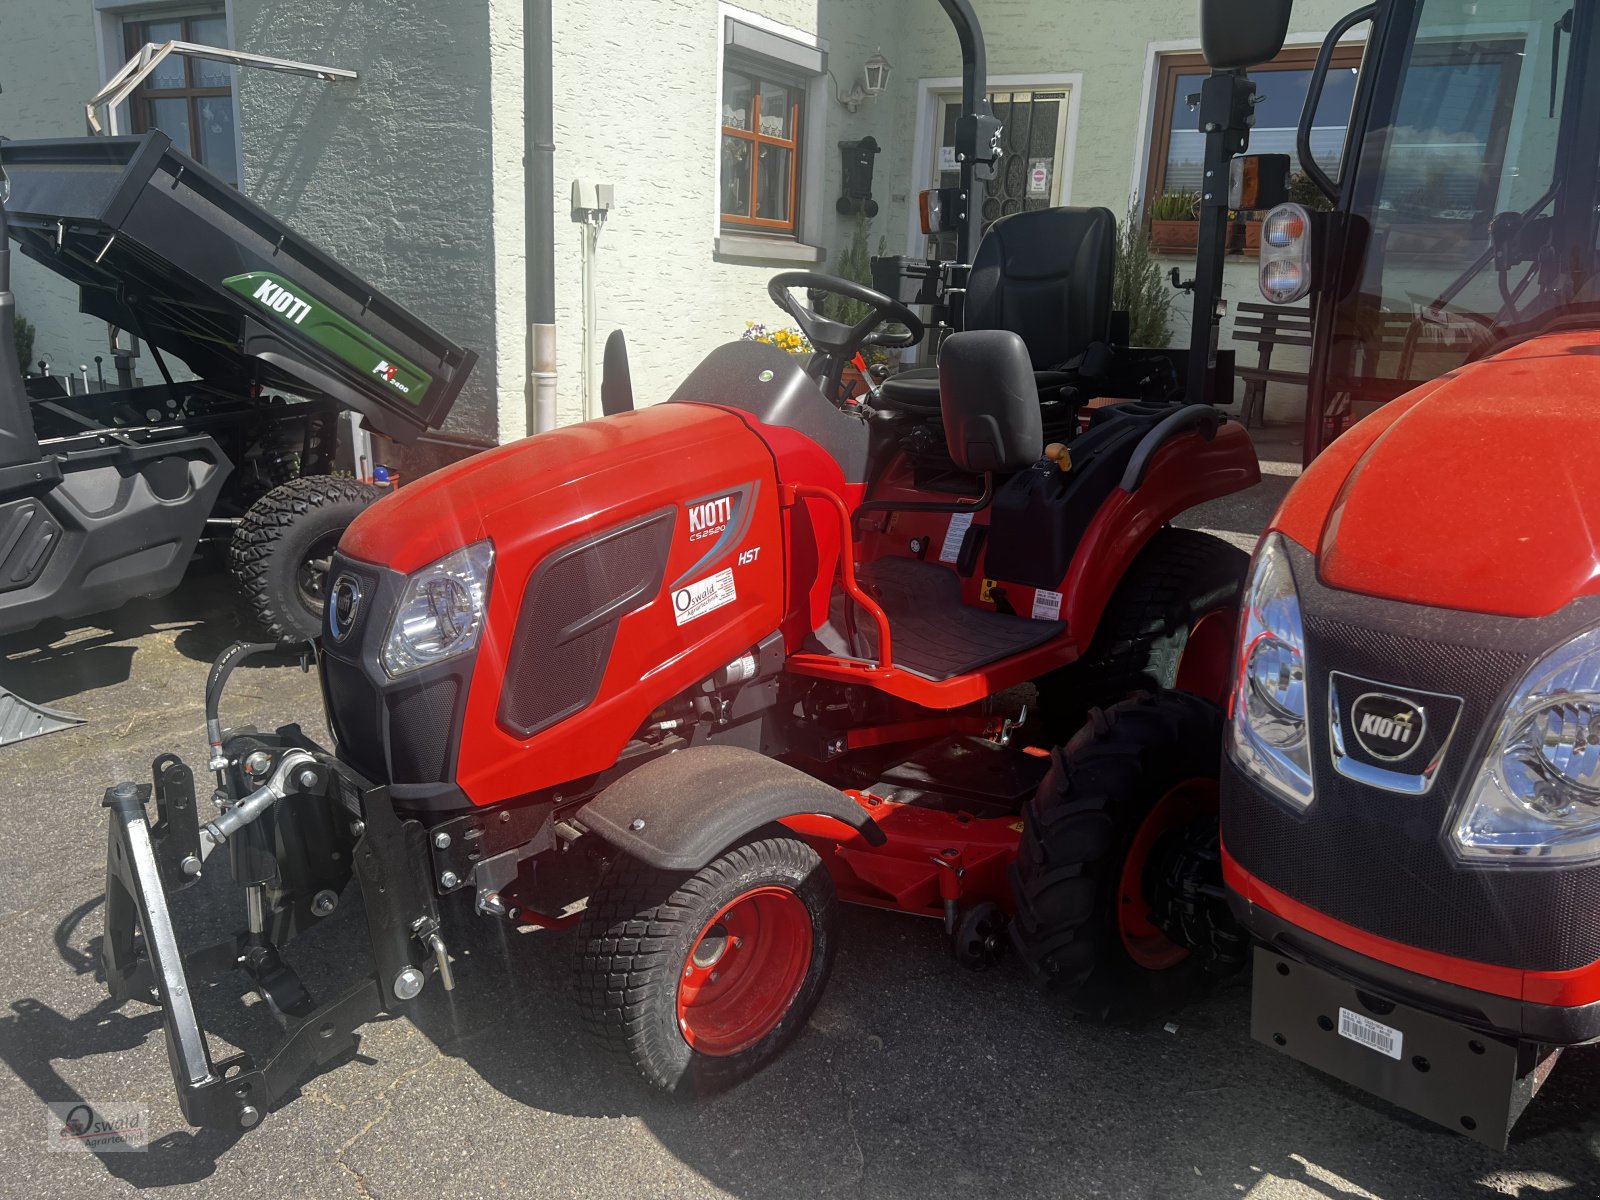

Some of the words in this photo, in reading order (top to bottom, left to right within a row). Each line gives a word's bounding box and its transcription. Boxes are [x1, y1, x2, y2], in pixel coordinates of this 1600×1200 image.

[252, 278, 312, 325] KIOTI
[389, 378, 409, 393] 2400
[688, 496, 731, 533] KIOTI
[689, 524, 726, 542] CS2520
[737, 546, 761, 566] HST
[675, 583, 715, 612] Oswald
[1359, 712, 1414, 743] KIOTI
